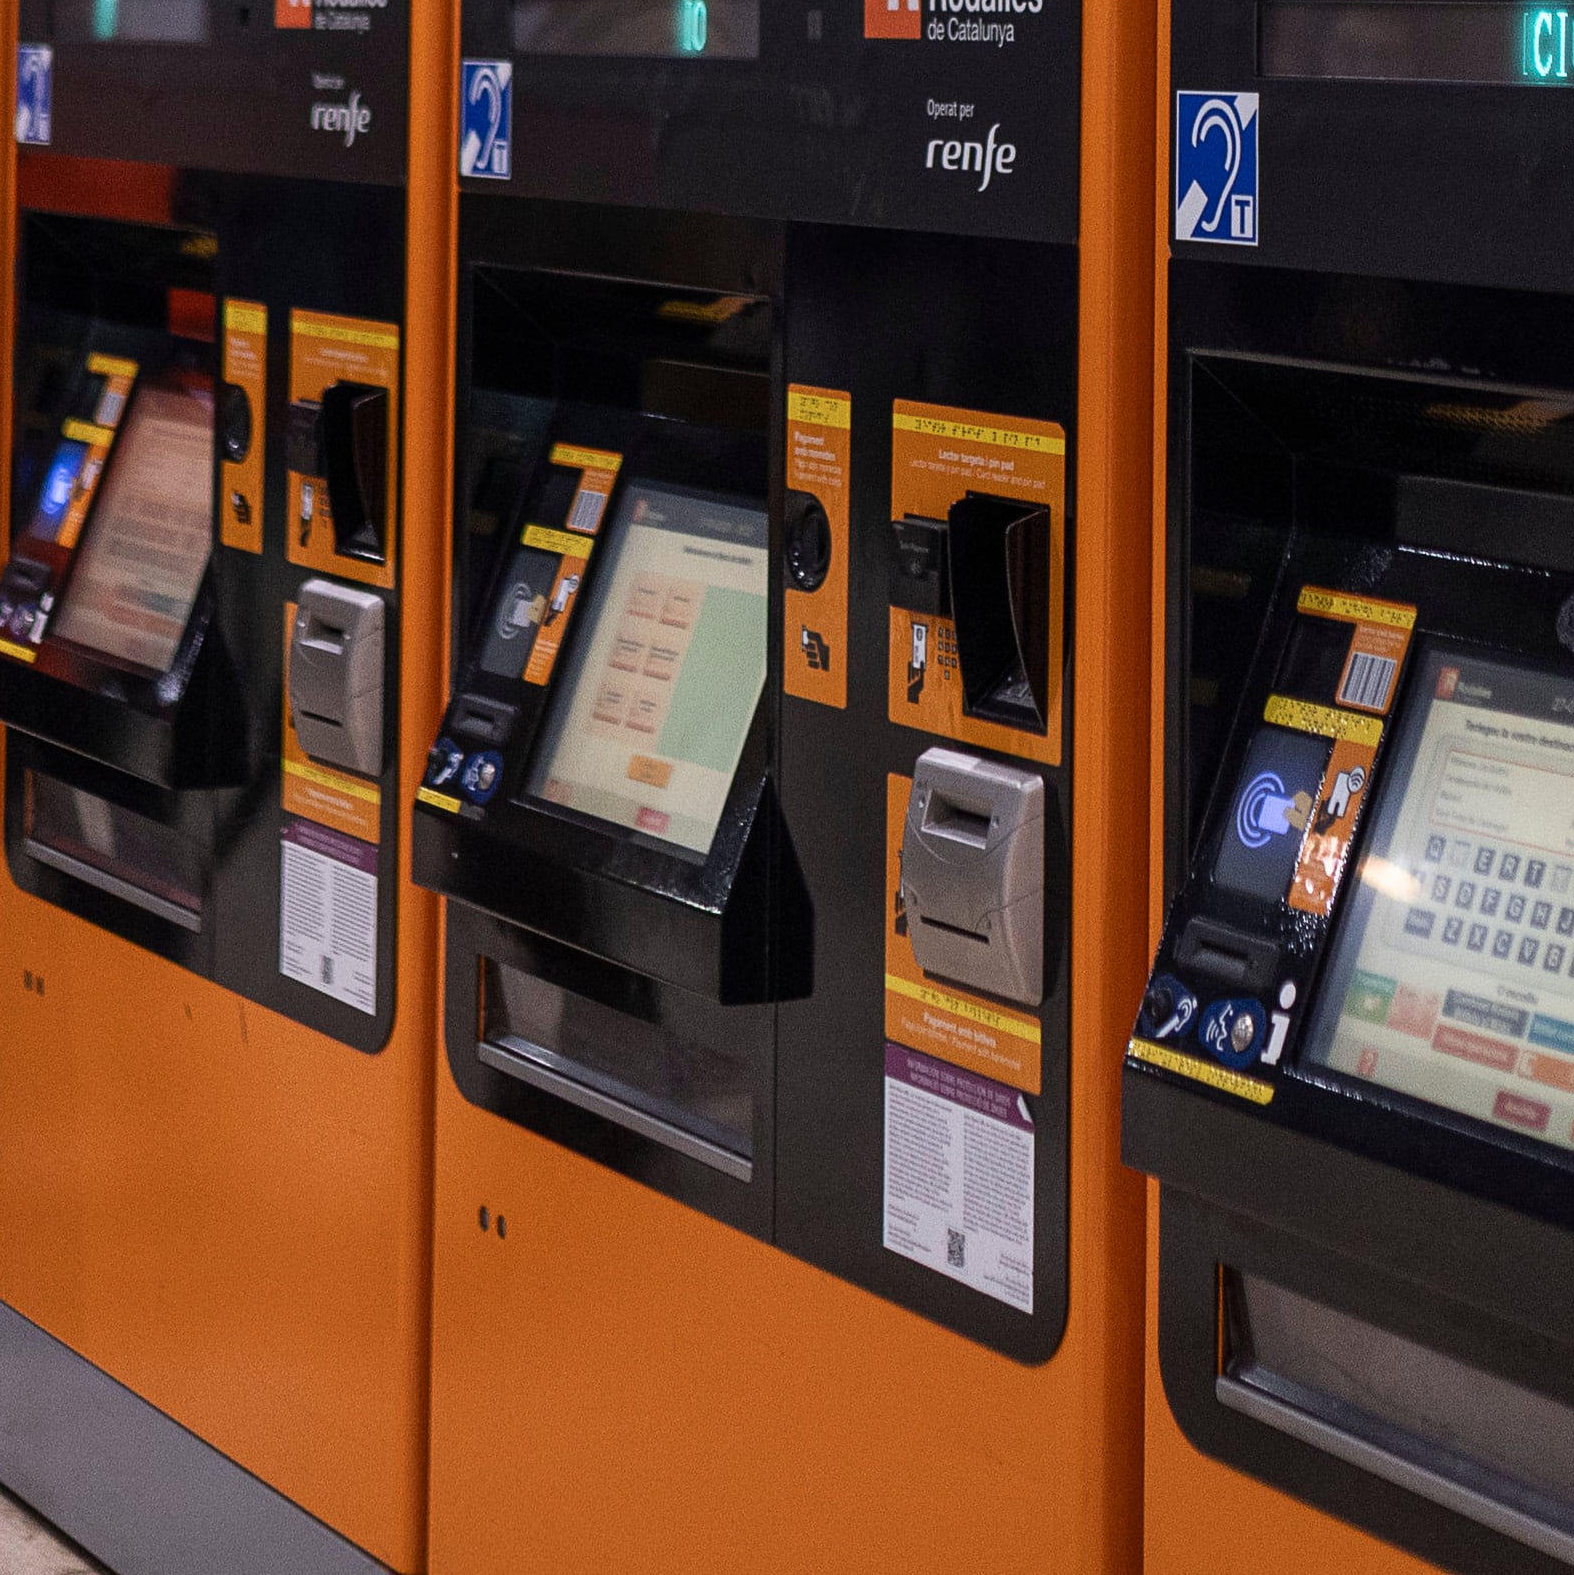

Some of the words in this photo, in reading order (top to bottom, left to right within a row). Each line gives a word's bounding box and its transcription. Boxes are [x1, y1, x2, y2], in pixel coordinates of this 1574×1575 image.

[927, 18, 944, 41] de
[947, 18, 1015, 47] Catalunya
[311, 90, 371, 148] renfe
[926, 98, 958, 121] Operat
[960, 102, 975, 122] per
[926, 123, 1017, 192] renfe
